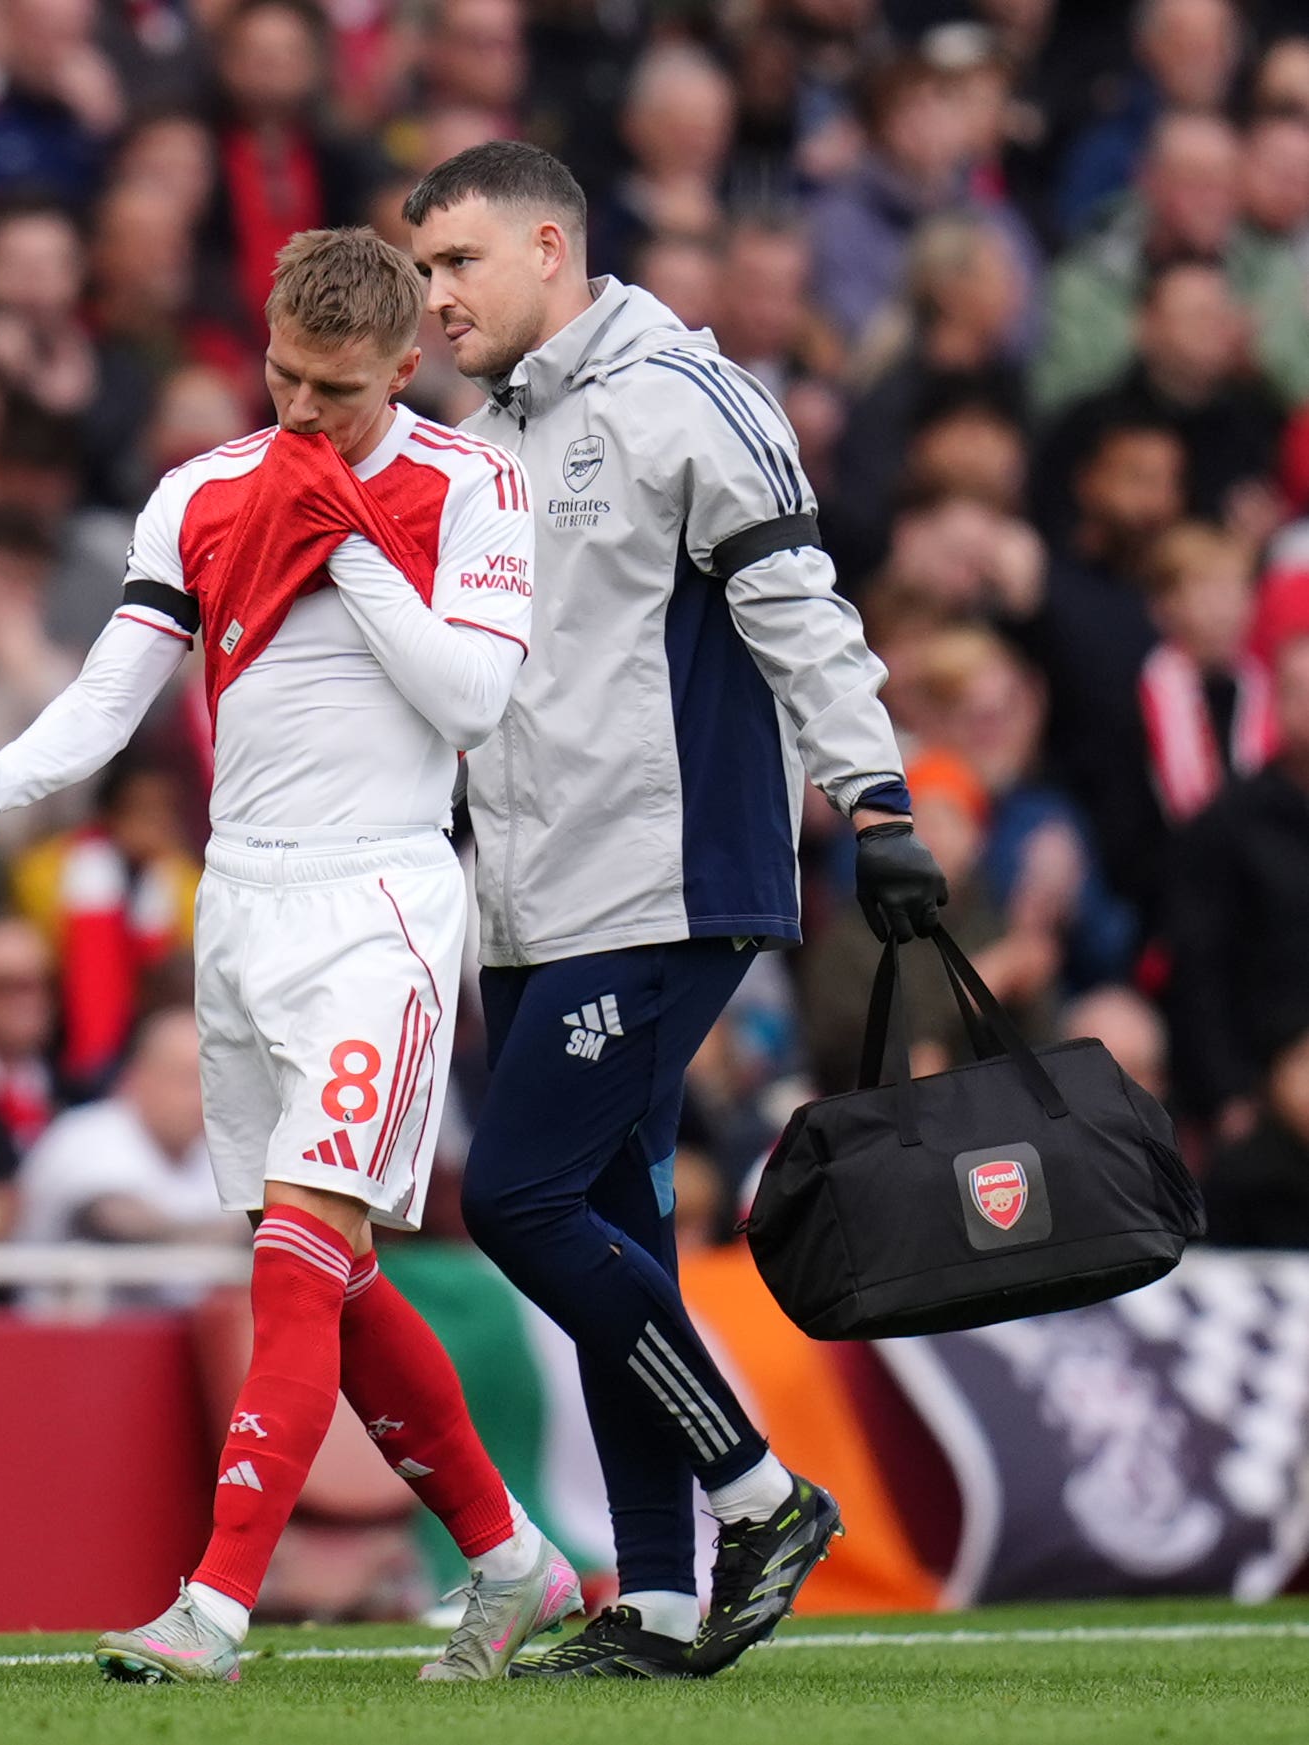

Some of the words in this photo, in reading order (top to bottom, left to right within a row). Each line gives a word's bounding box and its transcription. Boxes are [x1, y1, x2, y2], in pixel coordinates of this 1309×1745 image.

[548, 498, 611, 514] Emirates
[555, 515, 568, 528] FLY
[569, 514, 599, 527] BETTER
[485, 554, 528, 577] VISIT
[246, 836, 273, 849] Calvin
[275, 839, 299, 849] Klein
[565, 1027, 607, 1061] SM
[321, 1039, 382, 1124] 8
[977, 1169, 1018, 1187] Arsenal
